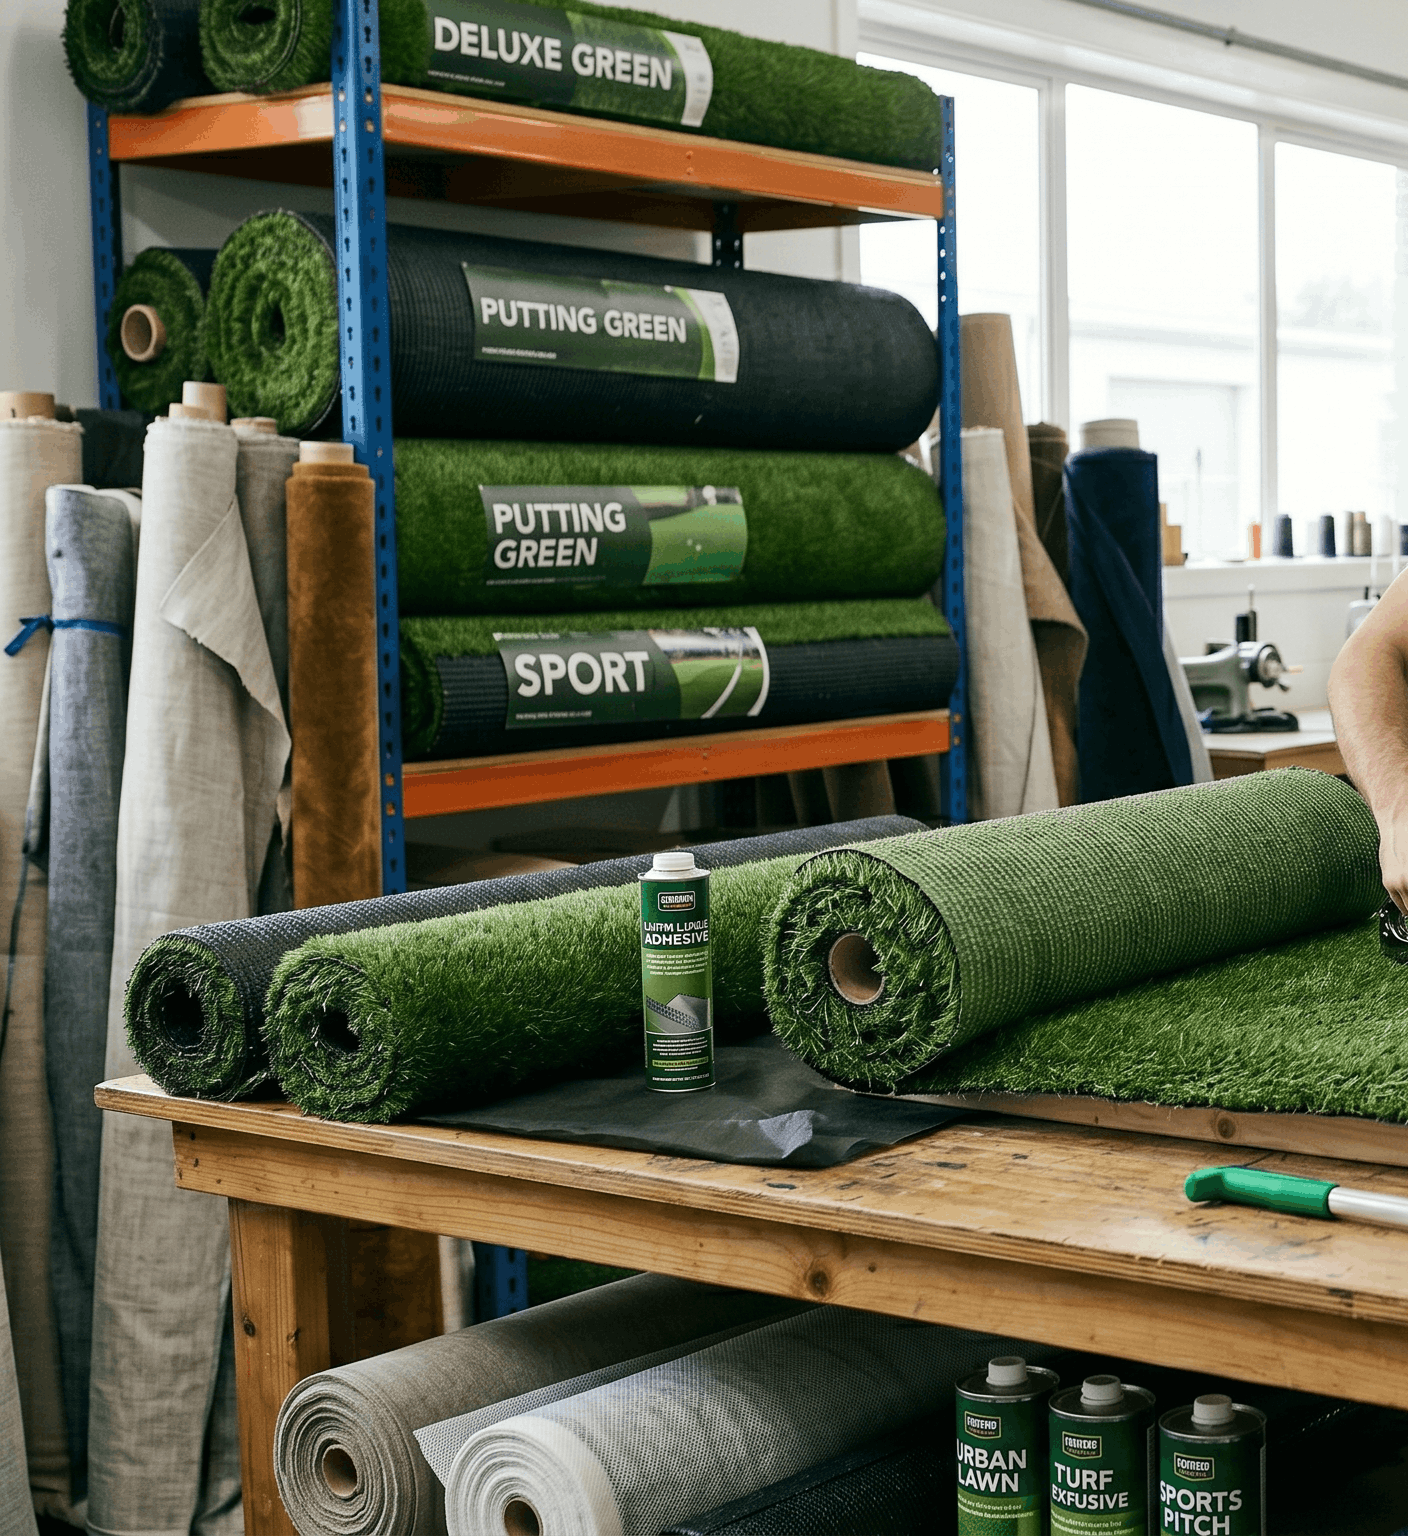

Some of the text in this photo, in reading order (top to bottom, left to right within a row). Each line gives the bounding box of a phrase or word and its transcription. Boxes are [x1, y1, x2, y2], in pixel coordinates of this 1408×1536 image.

[434, 16, 673, 91] DELUXE GREEN
[480, 297, 687, 344] PUTTING GREEN
[492, 502, 627, 535] PUTTING
[493, 537, 598, 570] GREEN
[514, 651, 650, 698] SPORT
[644, 930, 709, 946] ADHESIVE
[956, 1438, 1027, 1470] URBAN
[957, 1462, 1019, 1493] LAWN
[1054, 1462, 1114, 1491] TURF
[1052, 1483, 1129, 1510] EXFUSIVE
[1160, 1480, 1243, 1513] SPORTS
[1164, 1507, 1230, 1536] PITCH
